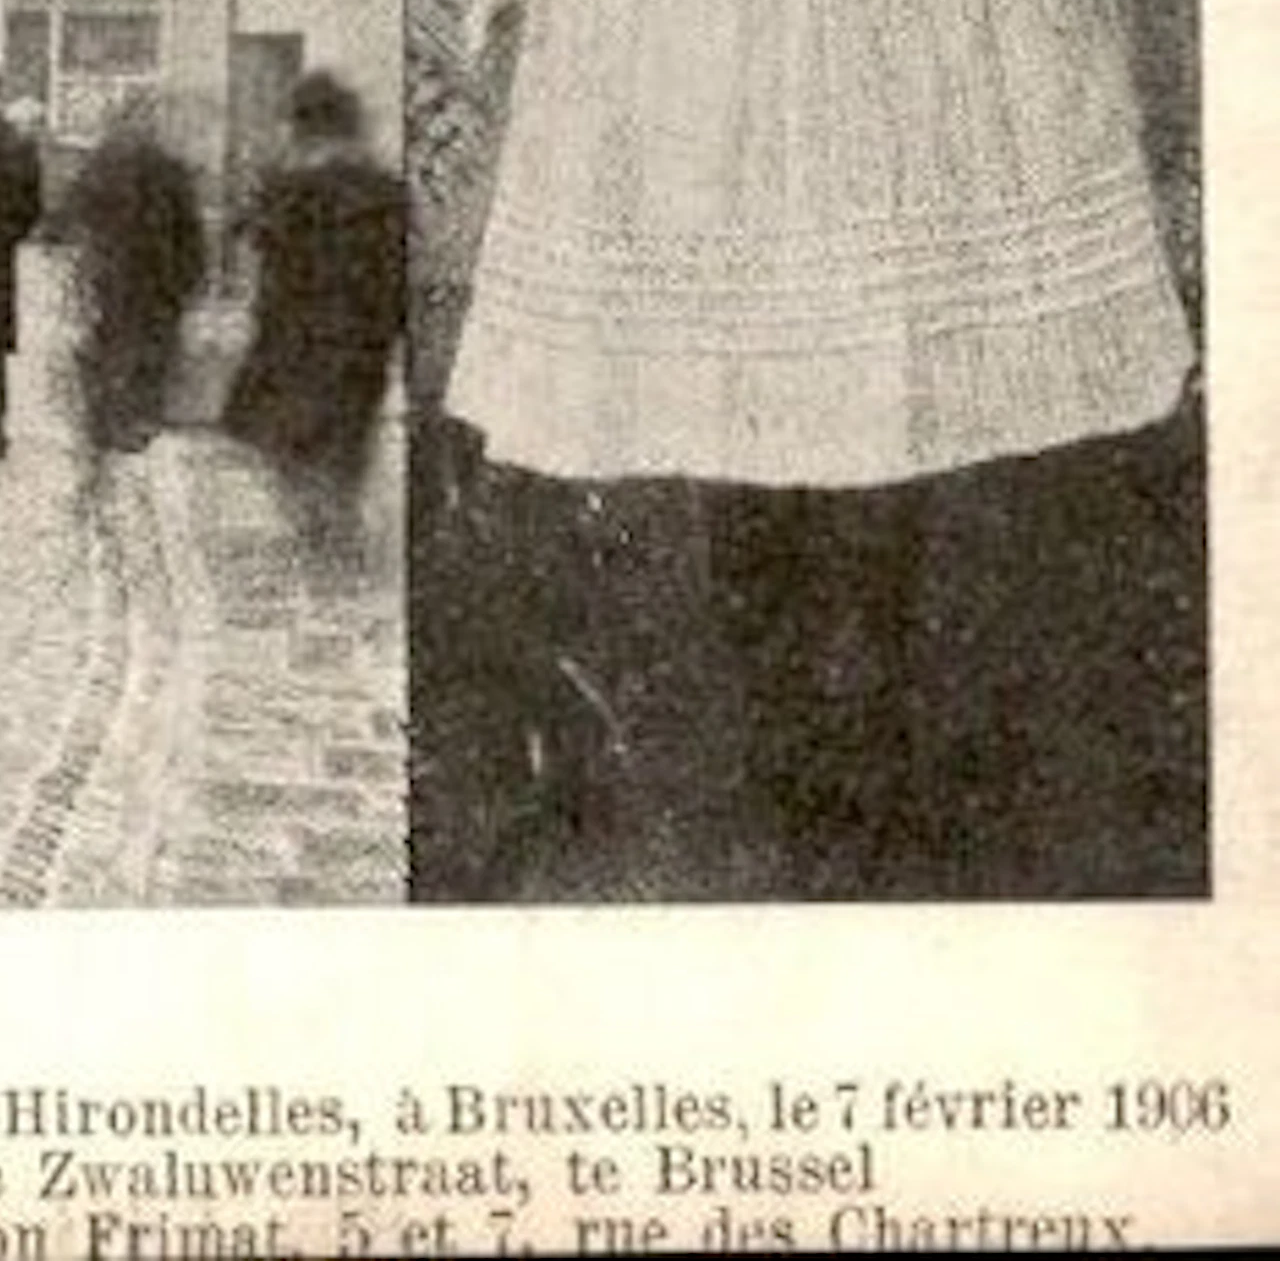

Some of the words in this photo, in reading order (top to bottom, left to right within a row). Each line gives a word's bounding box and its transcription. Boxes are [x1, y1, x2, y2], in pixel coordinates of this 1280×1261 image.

[3, 1085, 361, 1142] Hirondelles,
[395, 1088, 428, 1136] à
[447, 1083, 750, 1140] Bruxelles,
[770, 1081, 819, 1132] le
[836, 1082, 859, 1132] 7
[883, 1080, 1081, 1131] février
[1107, 1081, 1231, 1133] 1906
[40, 1149, 532, 1206] Zwaluwenstraat,
[566, 1149, 624, 1195] te
[658, 1142, 878, 1195] Brussel
[340, 1211, 370, 1256] 5
[401, 1211, 458, 1255] et
[576, 1216, 670, 1254] rue
